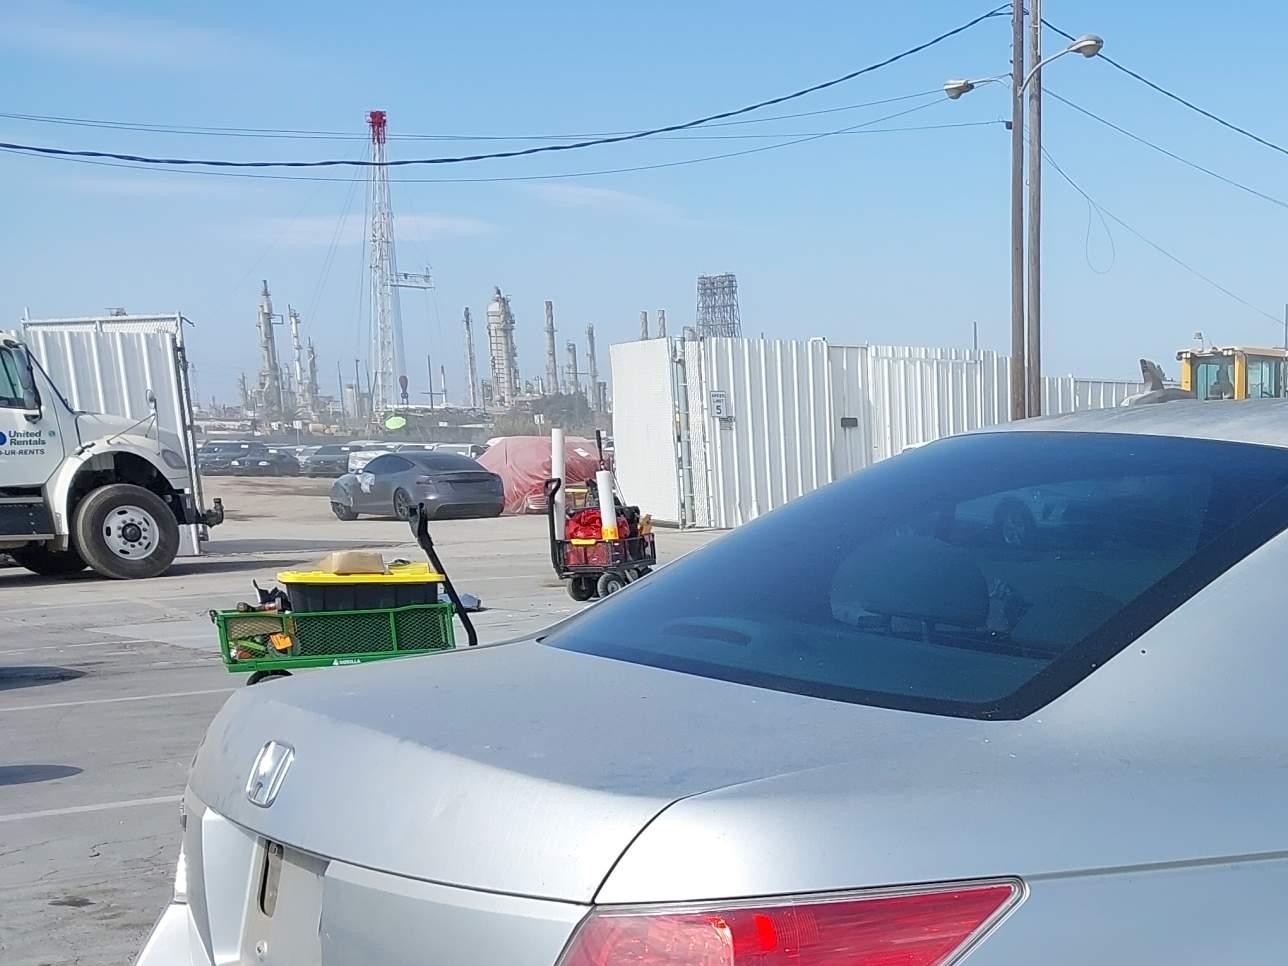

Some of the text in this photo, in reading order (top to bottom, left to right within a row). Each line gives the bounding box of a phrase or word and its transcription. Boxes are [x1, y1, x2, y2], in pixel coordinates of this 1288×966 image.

[716, 405, 722, 414] 5
[8, 430, 42, 438] United
[9, 438, 46, 446] Rentals
